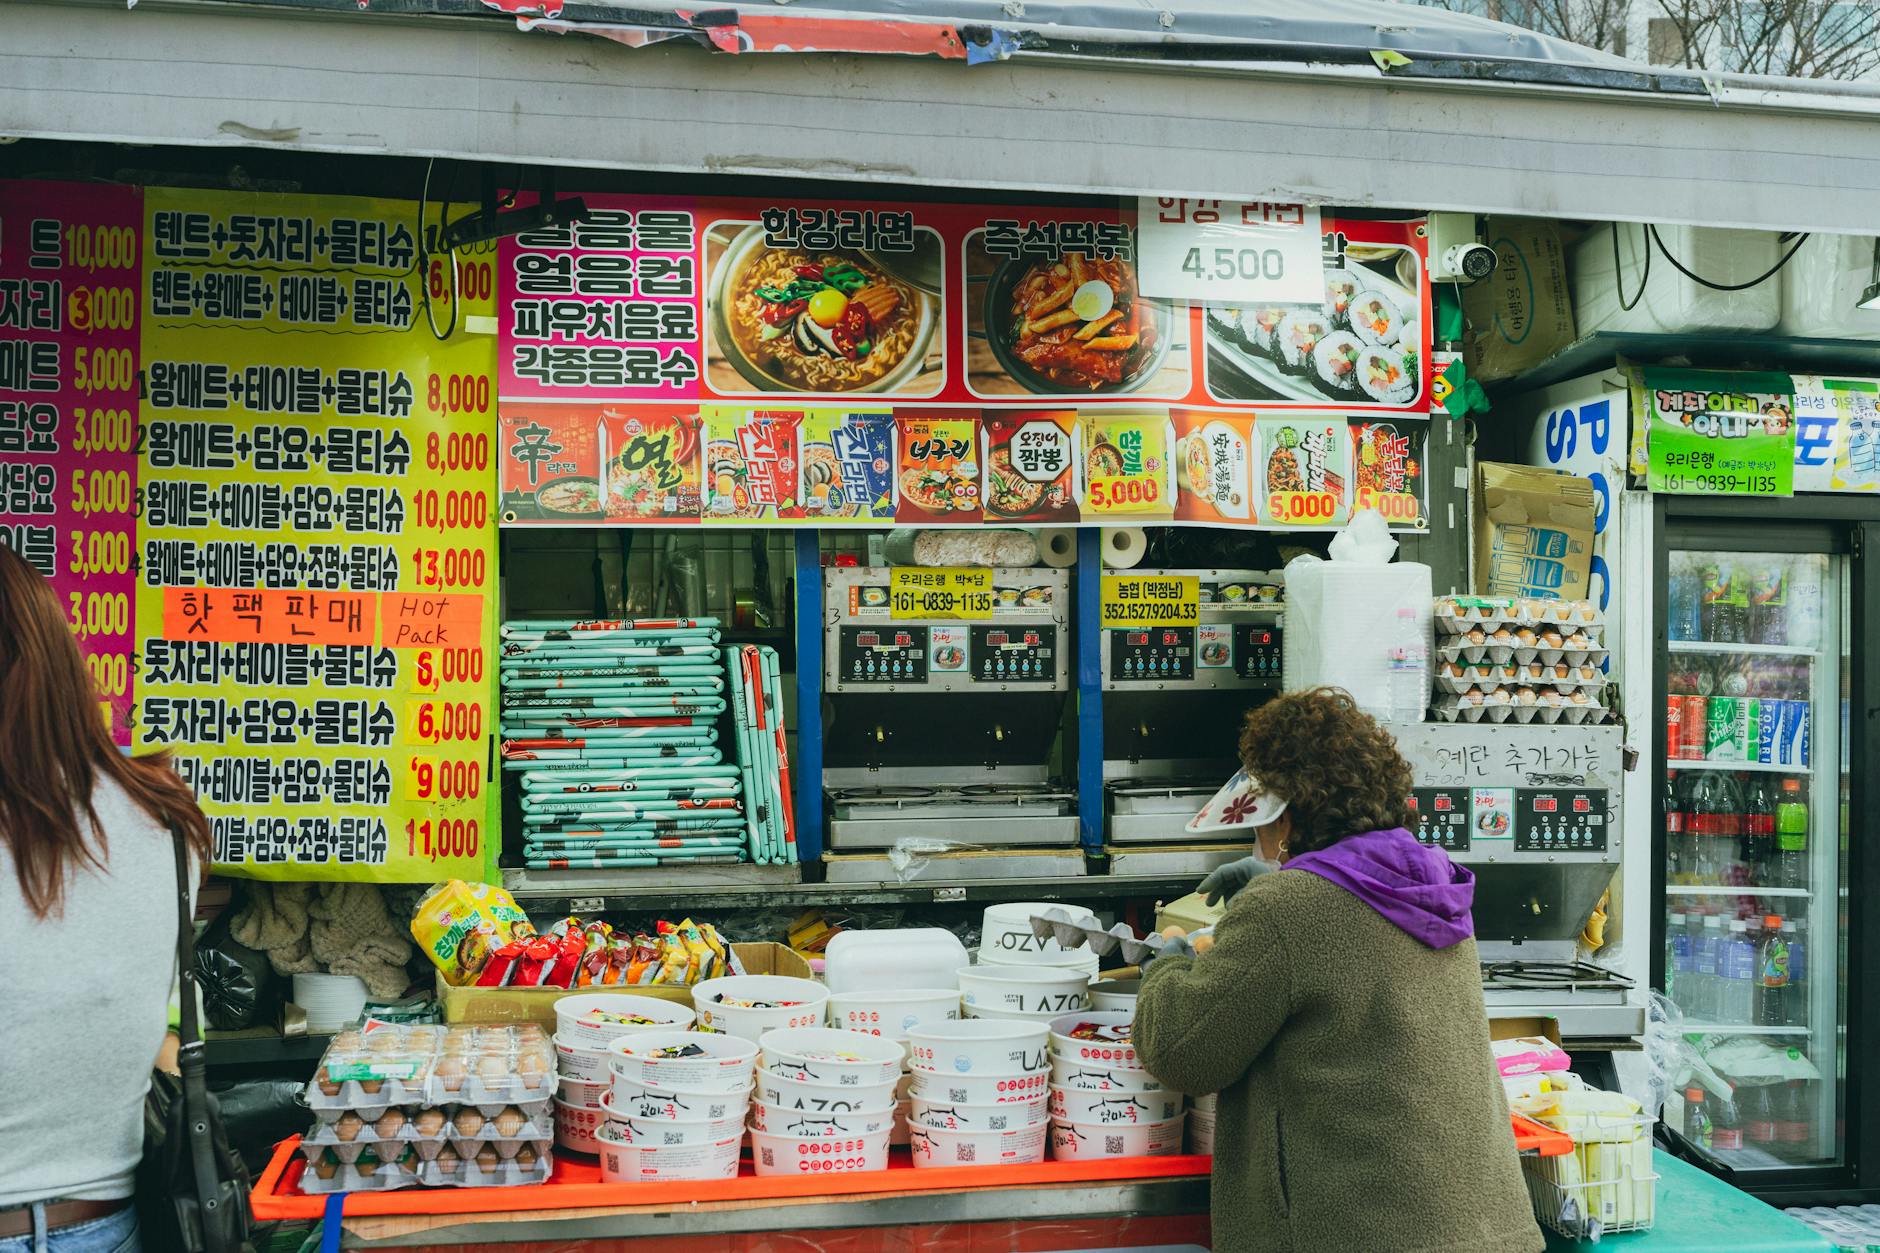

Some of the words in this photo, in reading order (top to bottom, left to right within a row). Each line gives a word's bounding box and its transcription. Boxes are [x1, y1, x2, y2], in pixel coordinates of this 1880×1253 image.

[66, 224, 136, 273] 10,000
[153, 211, 415, 269] 텐트+돗자리+물티슈
[762, 208, 915, 251] 한강라면
[985, 219, 1138, 262] 즉석떡볶
[513, 253, 696, 297] 얼음컵
[68, 286, 135, 334] 3,000
[512, 300, 698, 342] 파우치음료
[73, 347, 133, 397] 5,000
[513, 344, 699, 389] 각종음료수
[150, 362, 413, 416] 왕매트+테이블+물티슈
[427, 373, 489, 417] 8,000
[72, 408, 132, 457] 3,000
[149, 421, 411, 475] 왕매트+담요+물티슈
[426, 432, 488, 475] 8,000
[1020, 431, 1059, 448] 오징어
[1693, 415, 1749, 438] 안내
[734, 420, 778, 505] 진라면
[830, 424, 873, 505] 진라면
[910, 438, 970, 461] 너구리
[1018, 449, 1063, 472] 짬뽕
[1300, 431, 1327, 492] 짜파게
[1380, 433, 1409, 493] 불닭볶
[1665, 451, 1715, 470] 우리은행
[71, 469, 130, 519] 5,000
[1090, 479, 1158, 508] 5,000
[1663, 474, 1777, 492] 161-0839-1135
[147, 480, 405, 533] 왕매트+테이블+담요+물티슈
[413, 489, 486, 533] 10,000
[1269, 495, 1336, 521] 5,000
[69, 530, 129, 580] 3,000
[412, 547, 485, 591] 13,000
[893, 592, 990, 612] 161-0839-1135
[899, 574, 946, 586] 우리은행
[1118, 582, 1140, 599] 농협
[1143, 581, 1183, 600] (박정남)
[69, 592, 129, 640] 3,000
[1104, 603, 1197, 620] 352.1527.9204.33
[396, 623, 450, 645] Pack
[417, 648, 483, 692] 6,000
[143, 698, 395, 746] 돗자리+담요+물티슈
[417, 702, 482, 744] 6,000
[1761, 704, 1772, 763] POCARI
[1424, 774, 1465, 786] 500
[405, 818, 479, 863] 11,000
